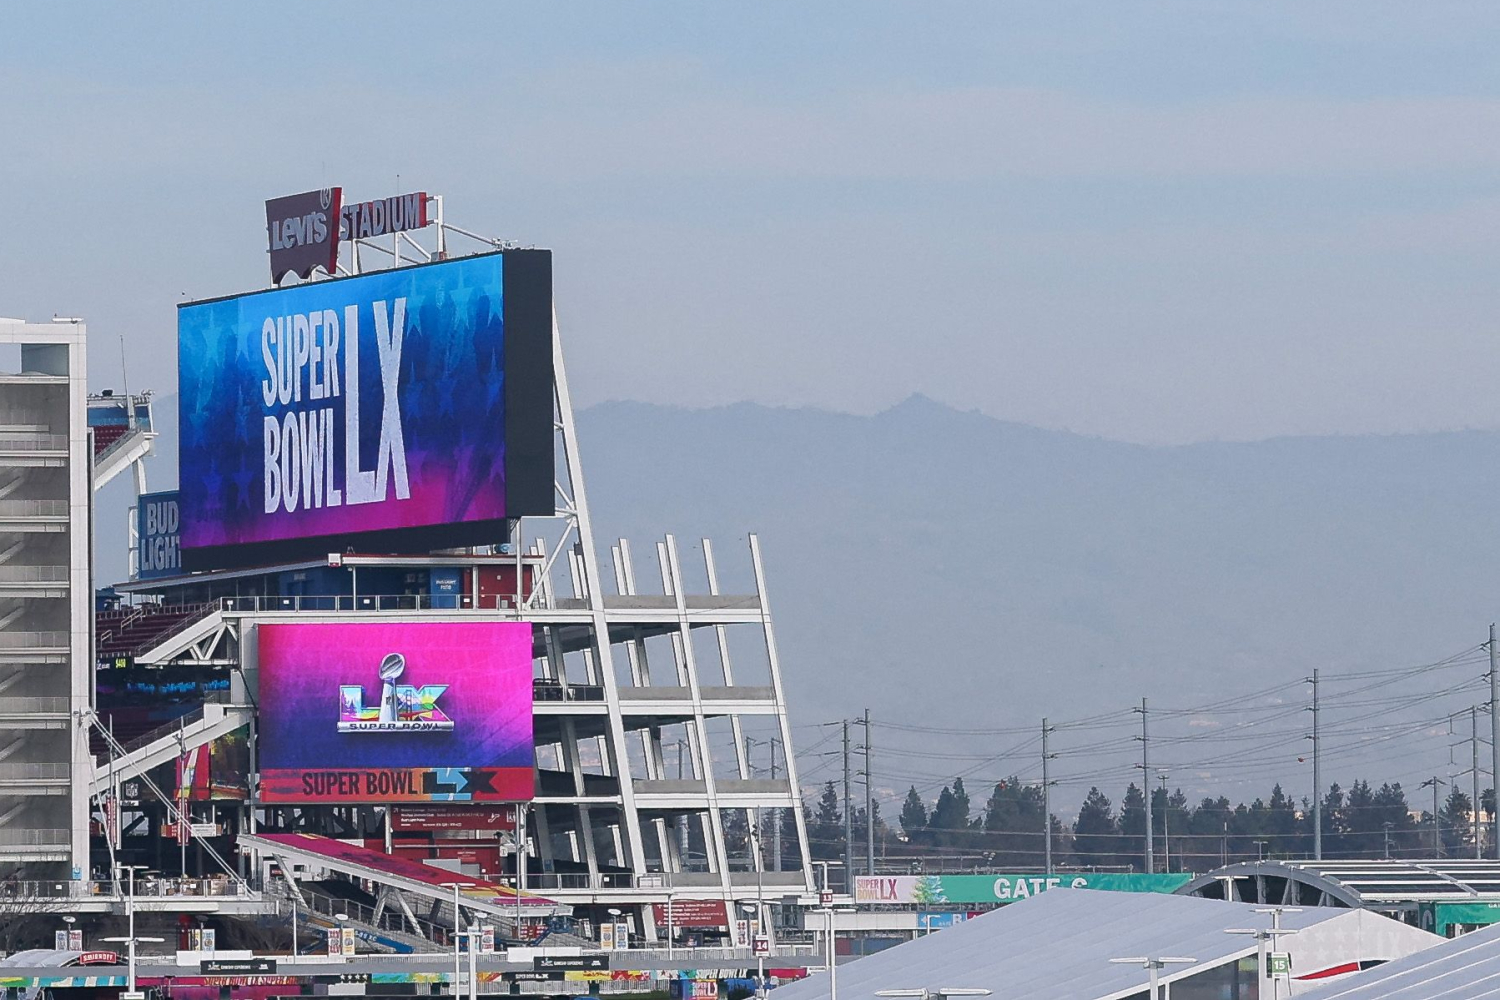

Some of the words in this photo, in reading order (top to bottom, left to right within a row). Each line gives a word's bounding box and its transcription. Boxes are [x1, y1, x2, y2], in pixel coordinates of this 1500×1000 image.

[340, 192, 420, 241] STADIUM
[262, 308, 340, 407] SUPER
[345, 296, 411, 506] LX
[264, 408, 342, 514] BOWL
[147, 501, 179, 535] BUD
[350, 723, 396, 731] SUPER
[402, 723, 443, 731] BOWL
[302, 771, 360, 795] SUPER
[366, 771, 418, 795] BOWL
[856, 879, 879, 889] SUPER
[880, 878, 897, 900] LX
[823, 894, 832, 902] 13
[857, 889, 878, 900] BOWL
[757, 941, 768, 950] 14
[83, 953, 114, 962] SMIRNOFF
[1274, 960, 1285, 970] 15
[696, 968, 718, 979] SUPER
[718, 968, 738, 978] BOWL
[738, 968, 748, 978] LX
